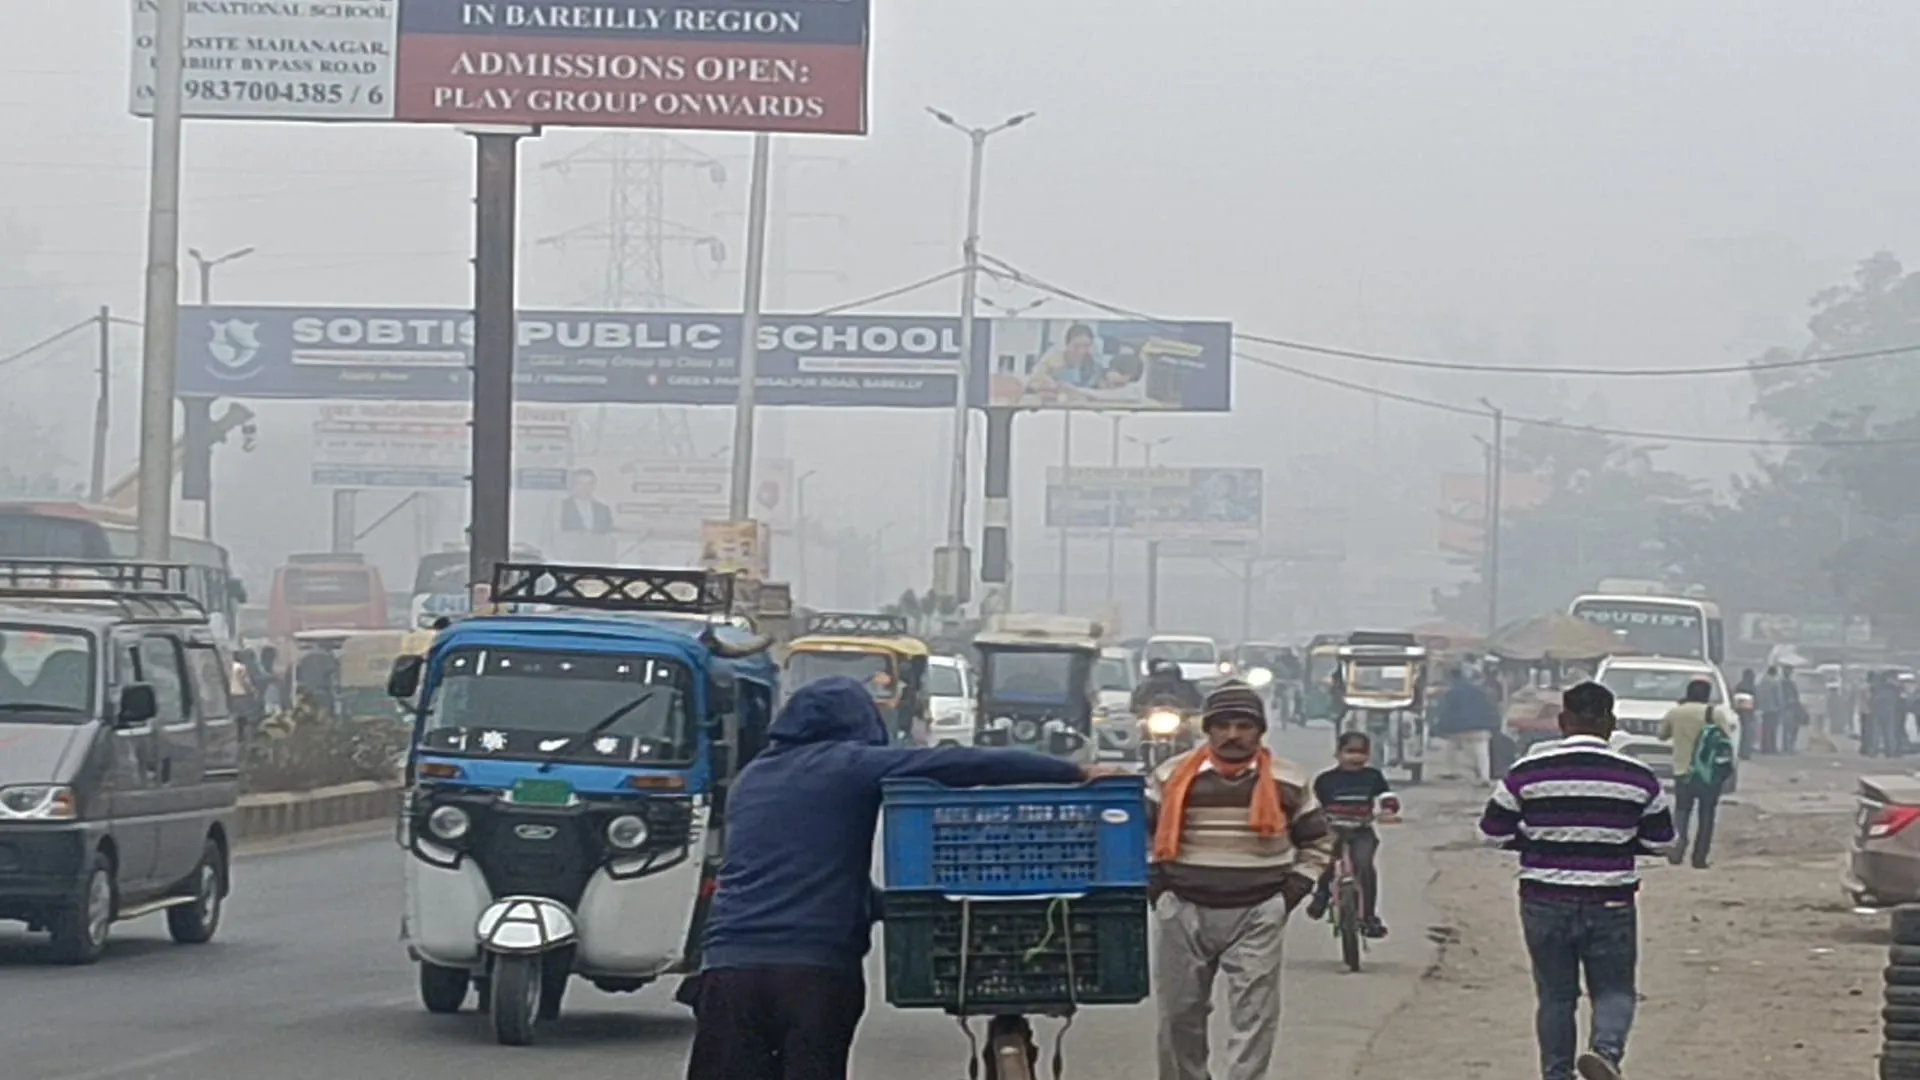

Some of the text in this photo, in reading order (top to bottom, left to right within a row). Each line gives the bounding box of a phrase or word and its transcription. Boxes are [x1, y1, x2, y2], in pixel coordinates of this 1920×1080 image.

[138, 0, 304, 18] INRNATIONAL
[462, 2, 801, 33] IN BAREILLY REGION
[241, 57, 313, 73] BYPASS
[320, 59, 377, 75] ROAD
[451, 51, 809, 84] ADMISSIONS OPEN:
[185, 79, 343, 104] 9837004385
[367, 85, 384, 105] 6
[433, 85, 825, 118] PLAY GROUP ONWARDS
[516, 320, 723, 350] PUBLIC
[756, 324, 960, 353] SCHOOL
